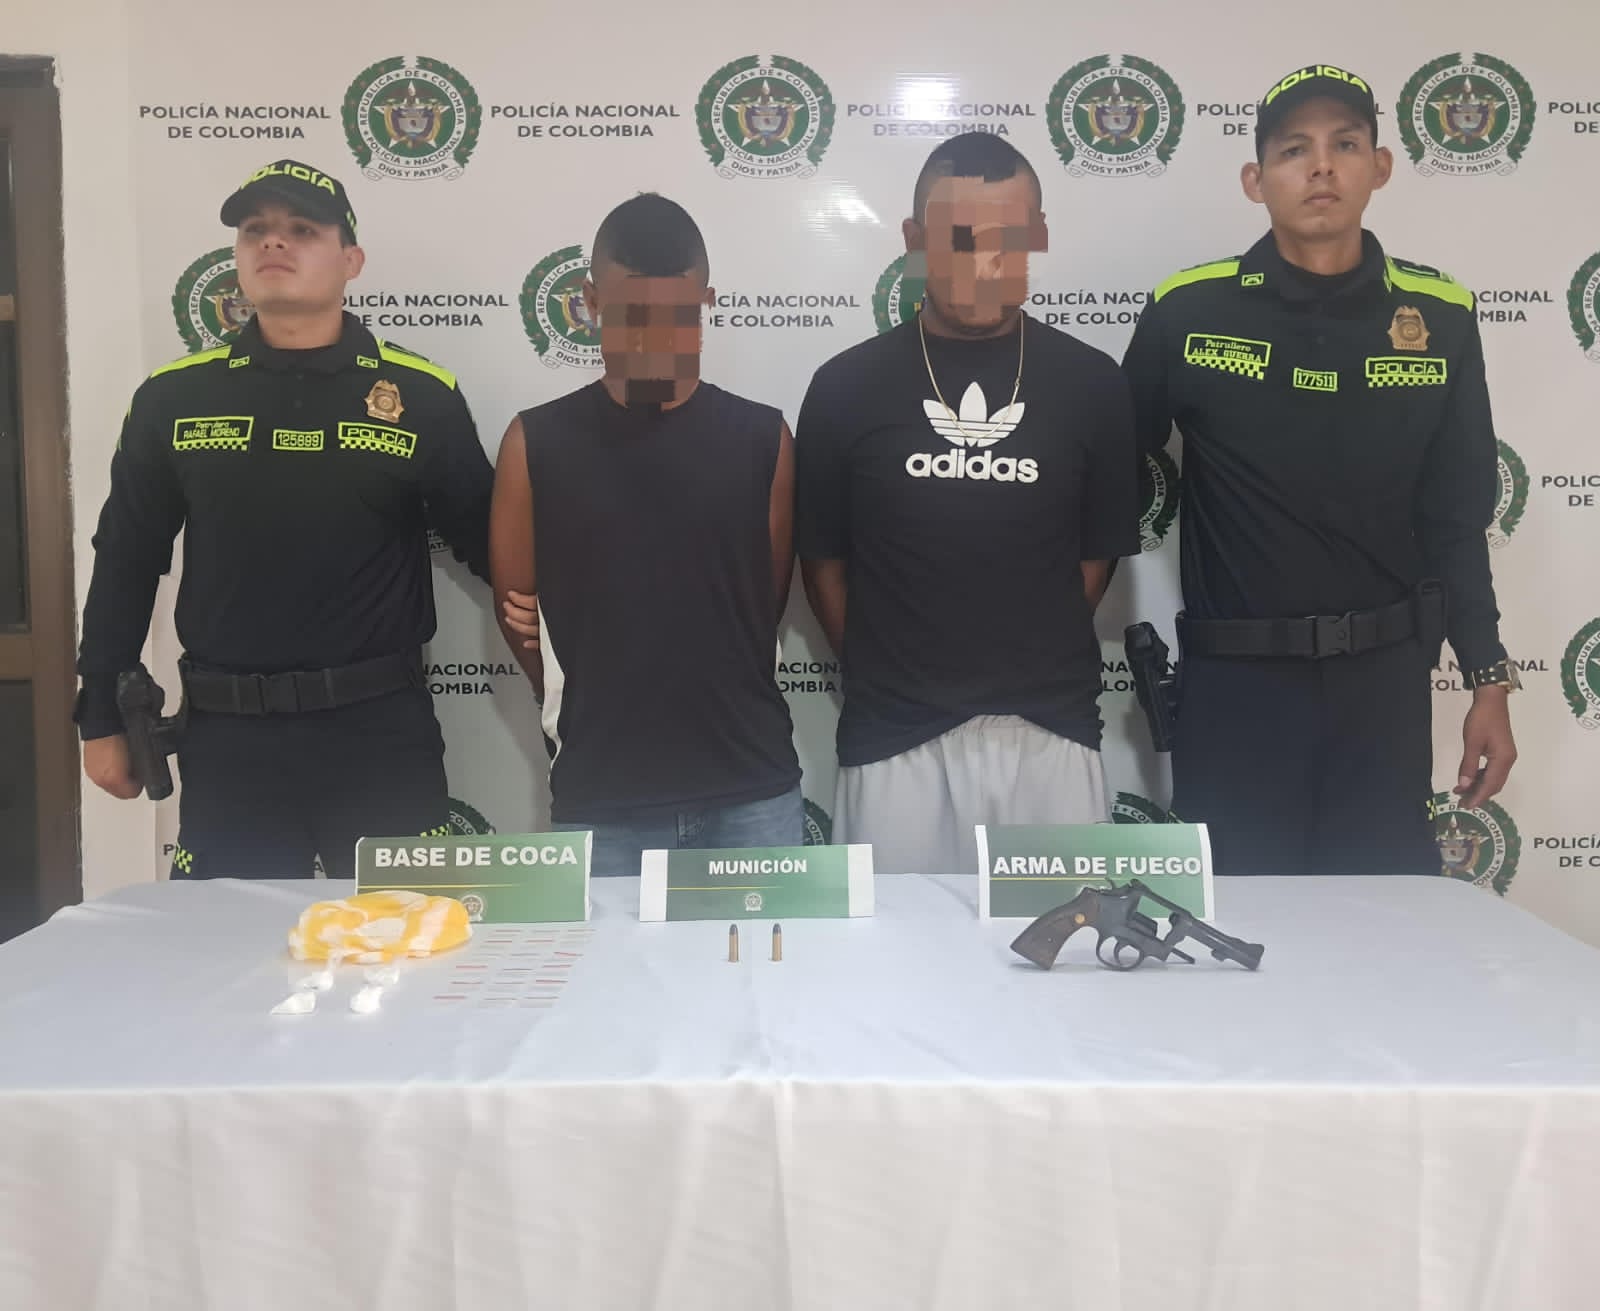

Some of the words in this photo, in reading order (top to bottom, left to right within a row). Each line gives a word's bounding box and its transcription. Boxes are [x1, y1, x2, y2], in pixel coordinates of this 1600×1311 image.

[431, 75, 465, 125] COLOMBIA
[1135, 73, 1168, 122] COLOMBIA
[1461, 66, 1476, 74] DE
[1487, 71, 1518, 121] COLOMBIA
[139, 102, 219, 119] POLICÍA
[225, 105, 331, 119] NACIONAL
[491, 102, 569, 118] POLICÍA
[575, 104, 680, 118] NACIONAL
[847, 103, 911, 117] POLIC
[937, 103, 1036, 117] ACIONAL
[168, 126, 193, 139] DE
[198, 125, 305, 139] COLOMBIA
[517, 125, 543, 138] DE
[548, 125, 654, 137] COLOMBIA
[873, 123, 898, 136] DE
[1223, 123, 1248, 136] DE
[1574, 121, 1599, 134] DE
[413, 137, 460, 165] NACIONAL
[1116, 134, 1162, 162] NACIONAL
[1466, 132, 1514, 161] NACIONAL
[413, 164, 449, 177] PATRIA
[1115, 160, 1152, 174] PATRIA
[1466, 159, 1502, 173] PATRIA
[404, 294, 509, 307] NACIONAL
[756, 295, 860, 308] NACIONAL
[1474, 290, 1554, 303] CIONAL
[378, 313, 484, 327] COLOMBIA
[730, 314, 834, 328] COLOMBIA
[1045, 312, 1071, 325] DE
[1205, 339, 1251, 352] Patrullero
[1192, 347, 1218, 357] ALEX
[1223, 349, 1262, 362] GUERRA
[1374, 361, 1438, 375] POLICÍA
[1297, 372, 1334, 387] 177511
[347, 427, 408, 449] POLICÍA
[905, 448, 1039, 483] adidas
[1568, 494, 1595, 507] DE
[778, 662, 840, 674] ACION
[375, 847, 446, 867] BASE
[455, 846, 491, 866] DE
[500, 846, 578, 866] COCA
[1559, 855, 1583, 868] DE
[708, 857, 807, 875] MUNICIÓN
[993, 856, 1066, 875] ARMA
[1074, 856, 1107, 874] DE
[1115, 856, 1202, 875] FUEGO
